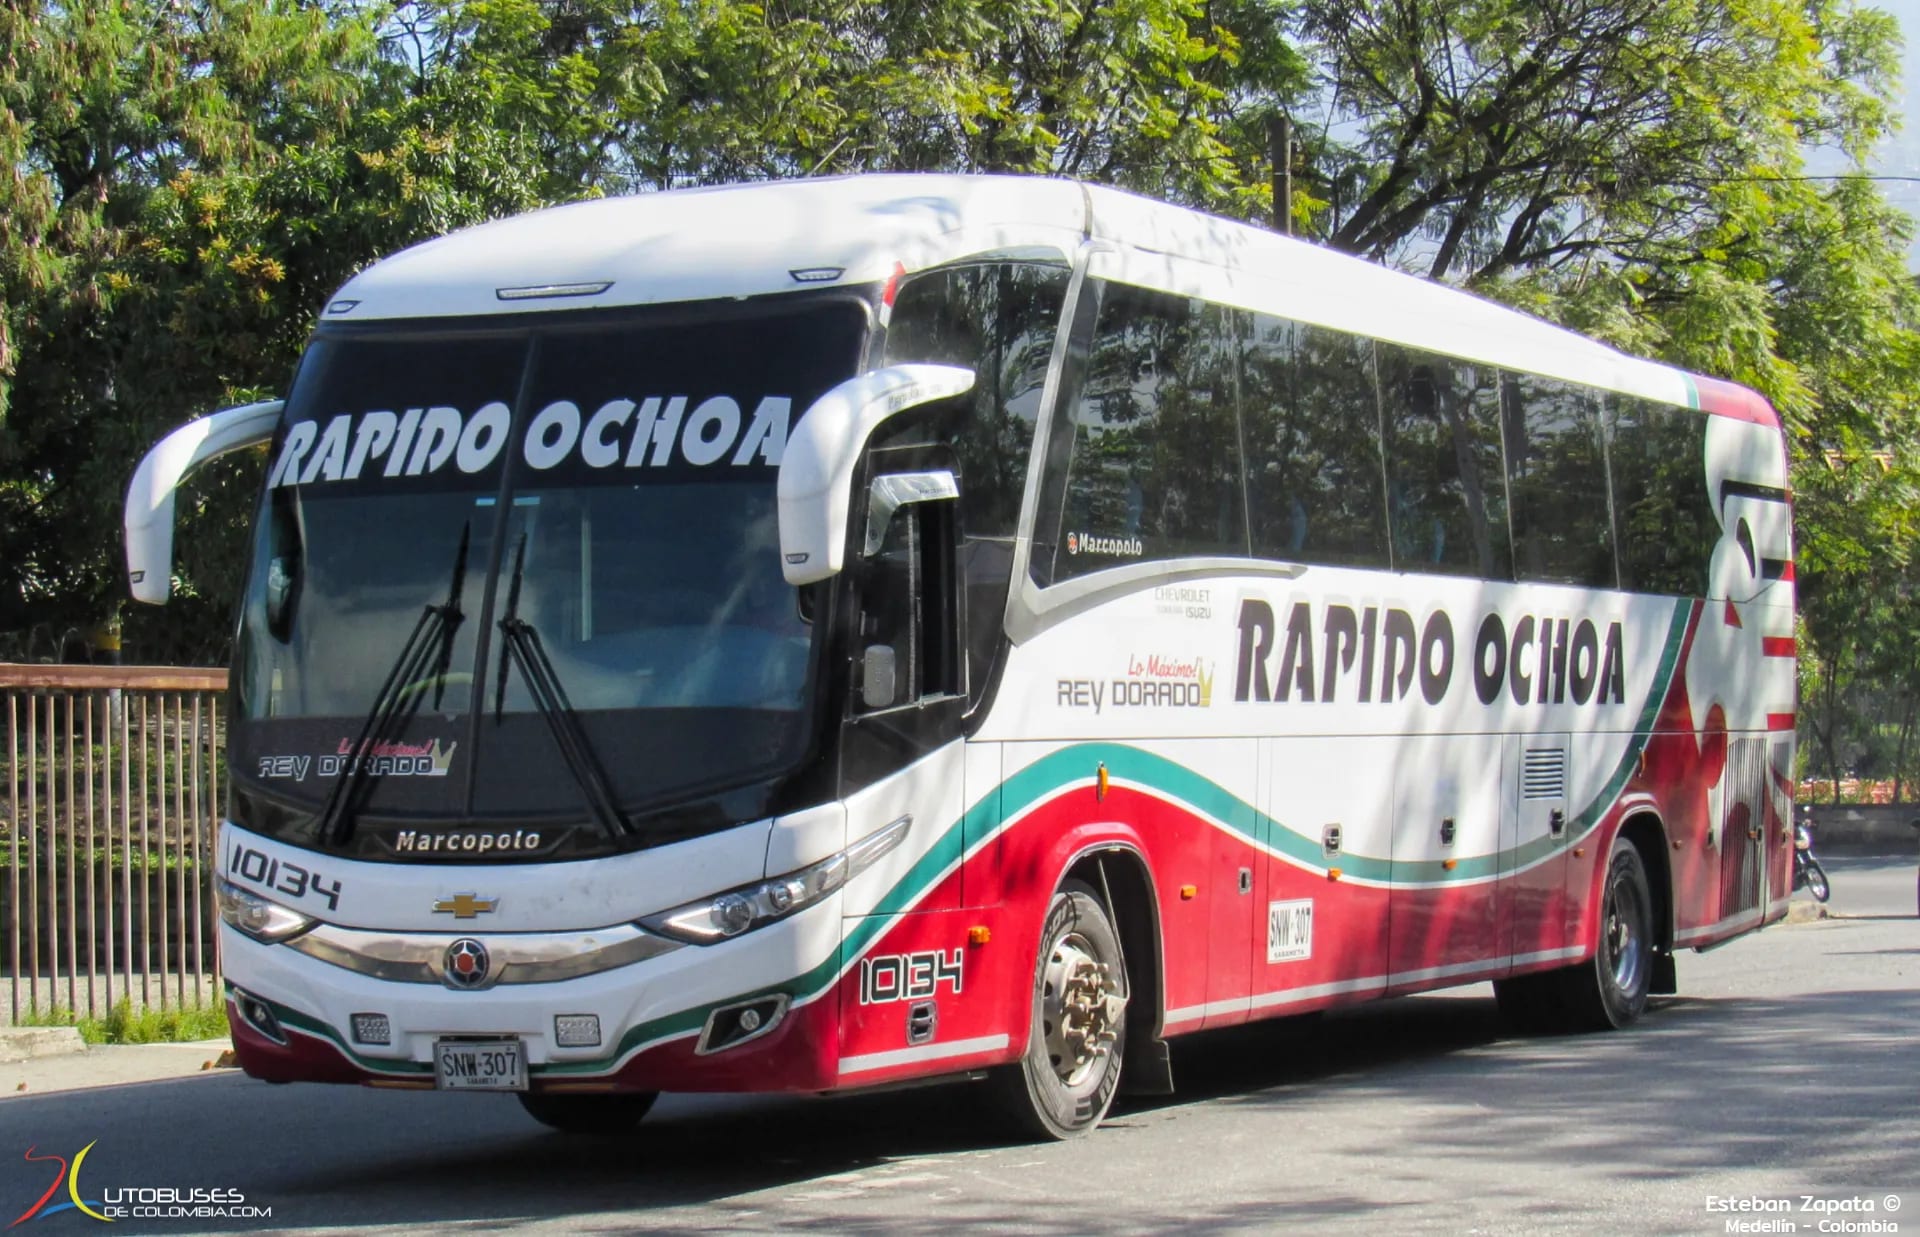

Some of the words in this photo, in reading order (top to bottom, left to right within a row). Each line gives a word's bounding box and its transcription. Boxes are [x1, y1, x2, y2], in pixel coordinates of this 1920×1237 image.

[268, 402, 511, 489] RAPIDO
[524, 396, 792, 469] OCHOA
[1079, 533, 1142, 557] Marcopolo
[1155, 587, 1211, 602] CHEVROLET
[1186, 607, 1212, 619] ISUZU
[1128, 653, 1144, 676] Lo
[1234, 598, 1455, 706] RAPIDO
[1473, 612, 1625, 706] OCHOA
[1112, 680, 1200, 707] DORADO
[396, 830, 541, 853] Marcopolo
[231, 843, 342, 912] 10134
[860, 947, 964, 1006] 10134
